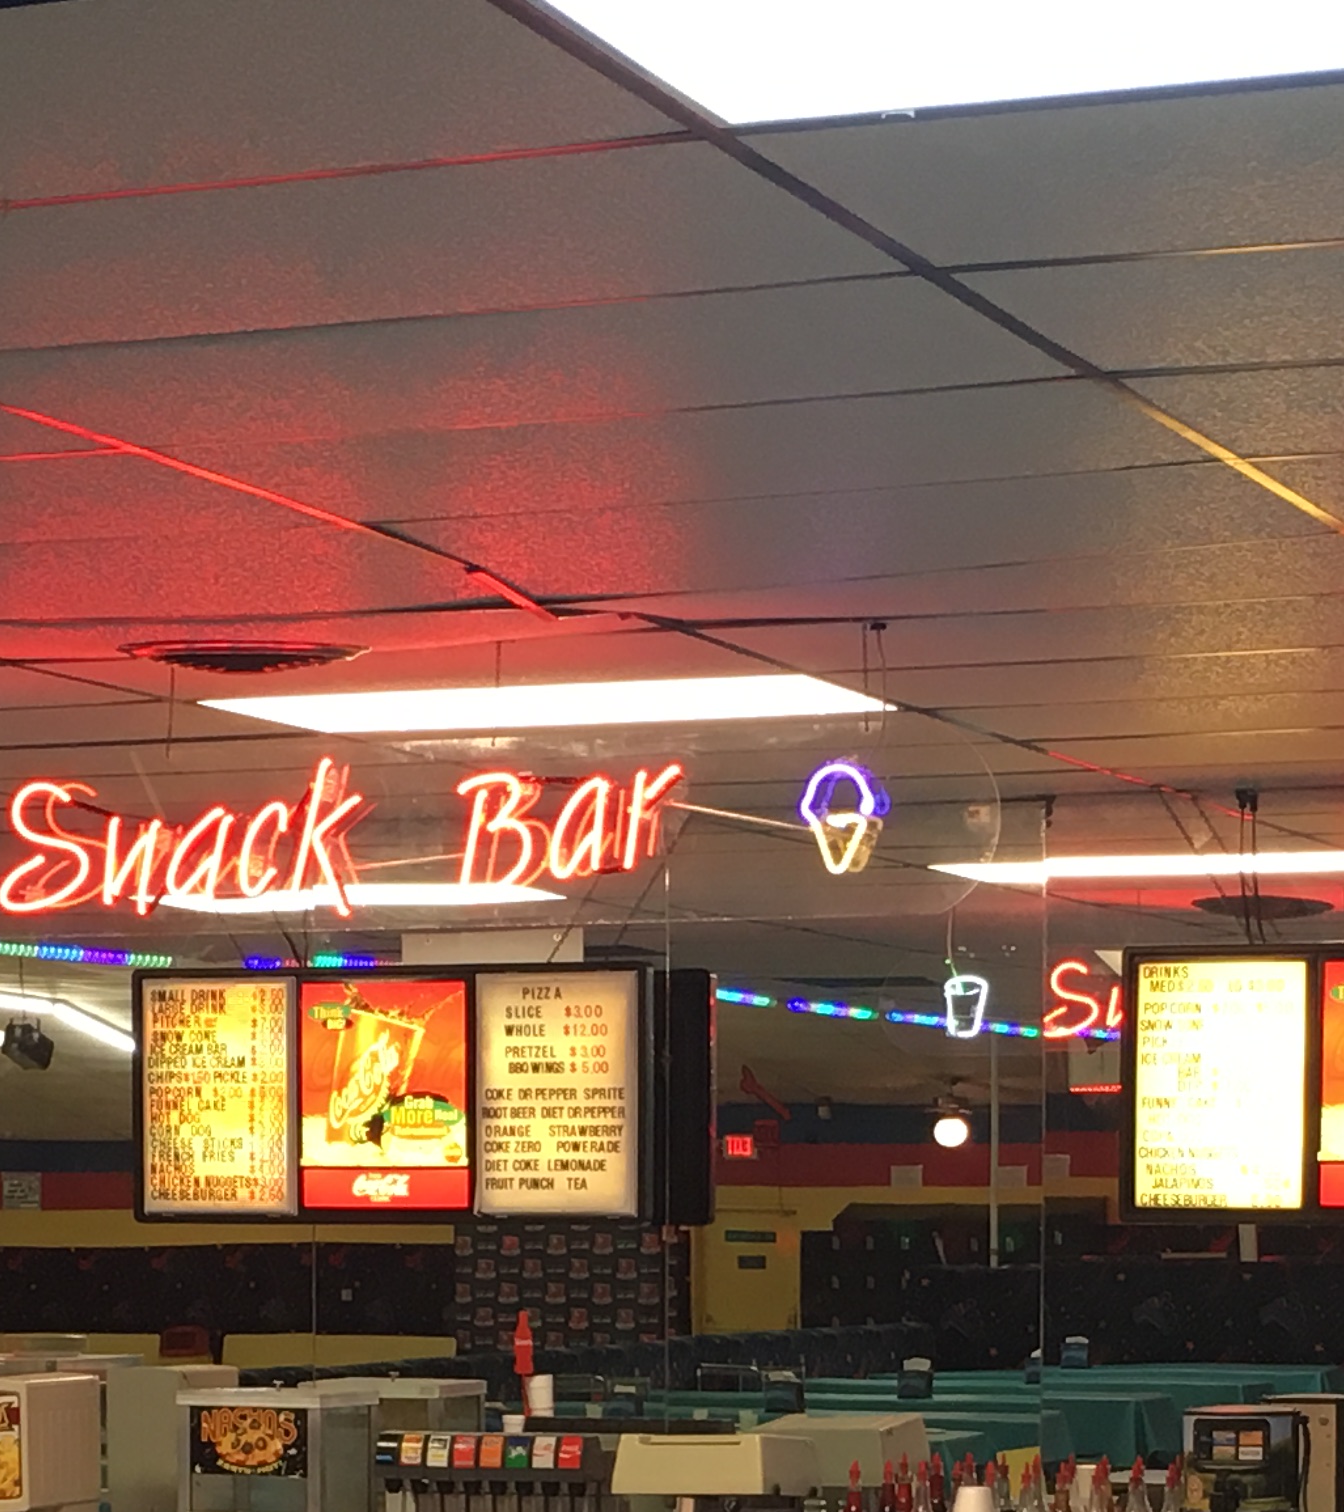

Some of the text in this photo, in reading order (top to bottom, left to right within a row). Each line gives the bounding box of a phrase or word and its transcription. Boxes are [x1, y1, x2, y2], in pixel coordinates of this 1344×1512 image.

[454, 763, 682, 892] Bar
[1143, 966, 1189, 979] DRINKS
[1150, 979, 1175, 993] MED
[150, 989, 186, 1002] SMALL
[190, 989, 226, 1002] DRINK
[522, 987, 563, 1000] PIZZA
[190, 1002, 226, 1015] DRINK
[313, 1006, 344, 1019] Think
[505, 1005, 603, 1019] SLICE $3.00
[152, 1015, 202, 1029] PITCHER
[151, 1030, 217, 1043] SNOW CONE
[504, 1023, 608, 1037] WHOLE $12.00
[169, 1044, 203, 1056] CREAM
[207, 1044, 227, 1056] BAR
[505, 1045, 556, 1058] PRETZEL
[148, 1056, 246, 1069] DIPPED ICE CREAM
[531, 1061, 565, 1074] WINGS
[148, 1071, 183, 1084] CHIPS
[213, 1071, 247, 1083] PICKLE
[149, 1086, 202, 1099] POPCORN
[485, 1087, 625, 1101] COKE DR PEPPER SPRITE
[150, 1099, 191, 1112] FUNNEL
[198, 1098, 226, 1111] CAKE
[404, 1095, 435, 1109] Grab
[150, 1112, 201, 1124] HOT DOG
[390, 1107, 433, 1125] More
[482, 1106, 626, 1119] ROOT BEER DIET DR PEPPER
[150, 1125, 212, 1136] CORN DOG
[485, 1124, 623, 1138] ORANGE STRAWBERRY
[151, 1138, 243, 1150] CHEESE STICKS
[484, 1140, 621, 1153] COKE ZERO POWERADE
[151, 1151, 194, 1163] FRENCH
[202, 1151, 235, 1162] FRIES
[150, 1163, 195, 1175] NACHOS
[485, 1159, 607, 1172] DIET COKE LEMONADE
[1146, 1163, 1197, 1175] NACHOS
[150, 1175, 199, 1188] CHICKEN
[205, 1175, 251, 1188] NUGGETS
[485, 1177, 588, 1191] FRUIT PUNCH TEA
[151, 1188, 237, 1201] CHEESEBURGER
[201, 1407, 298, 1445] NACHOS
